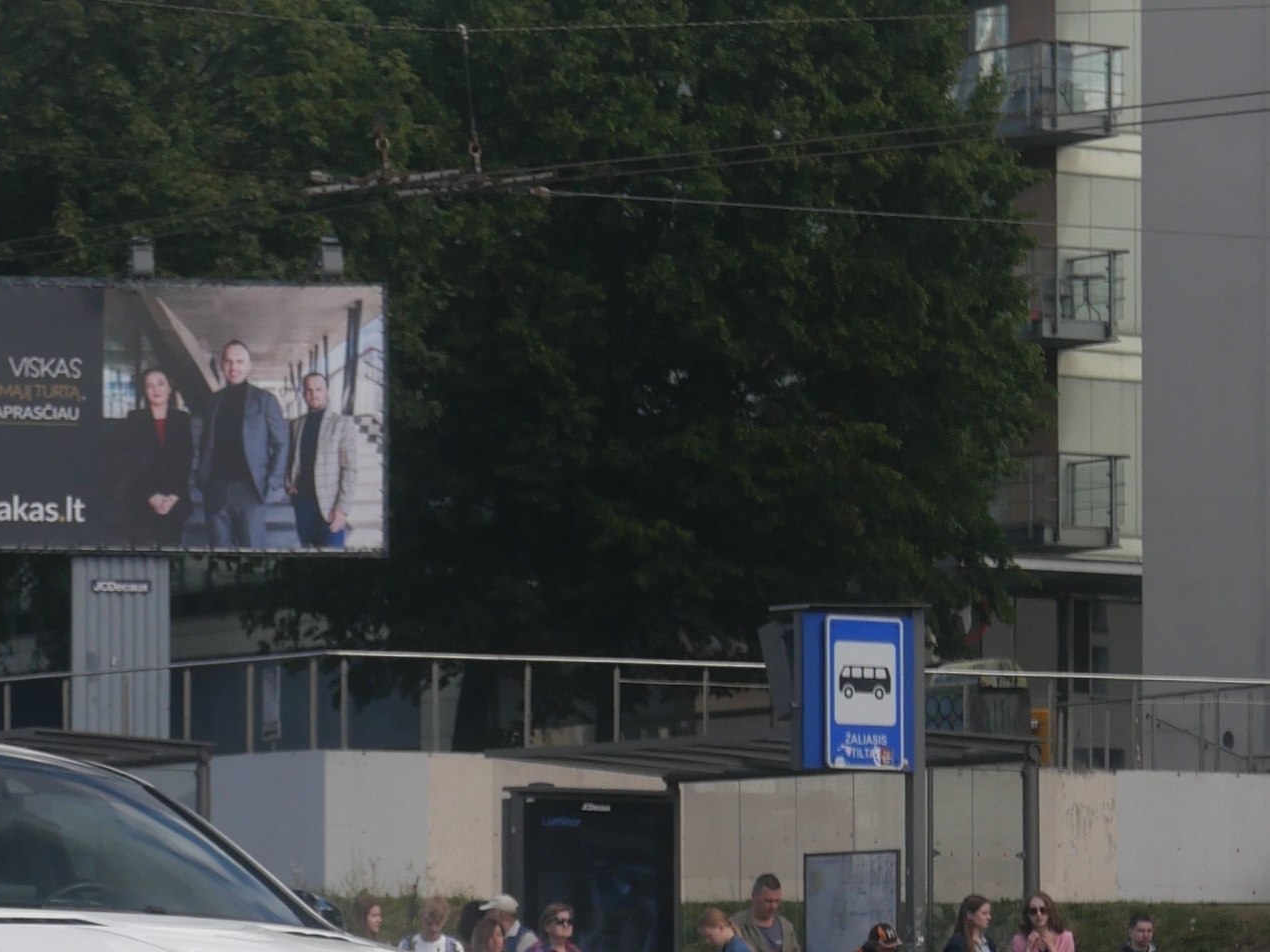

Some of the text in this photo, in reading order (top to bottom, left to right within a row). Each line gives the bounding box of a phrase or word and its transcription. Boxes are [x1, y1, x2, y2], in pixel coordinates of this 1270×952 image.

[8, 356, 83, 380] VISKAS
[845, 731, 888, 746] ŽALIASIS
[852, 747, 877, 760] TILTA
